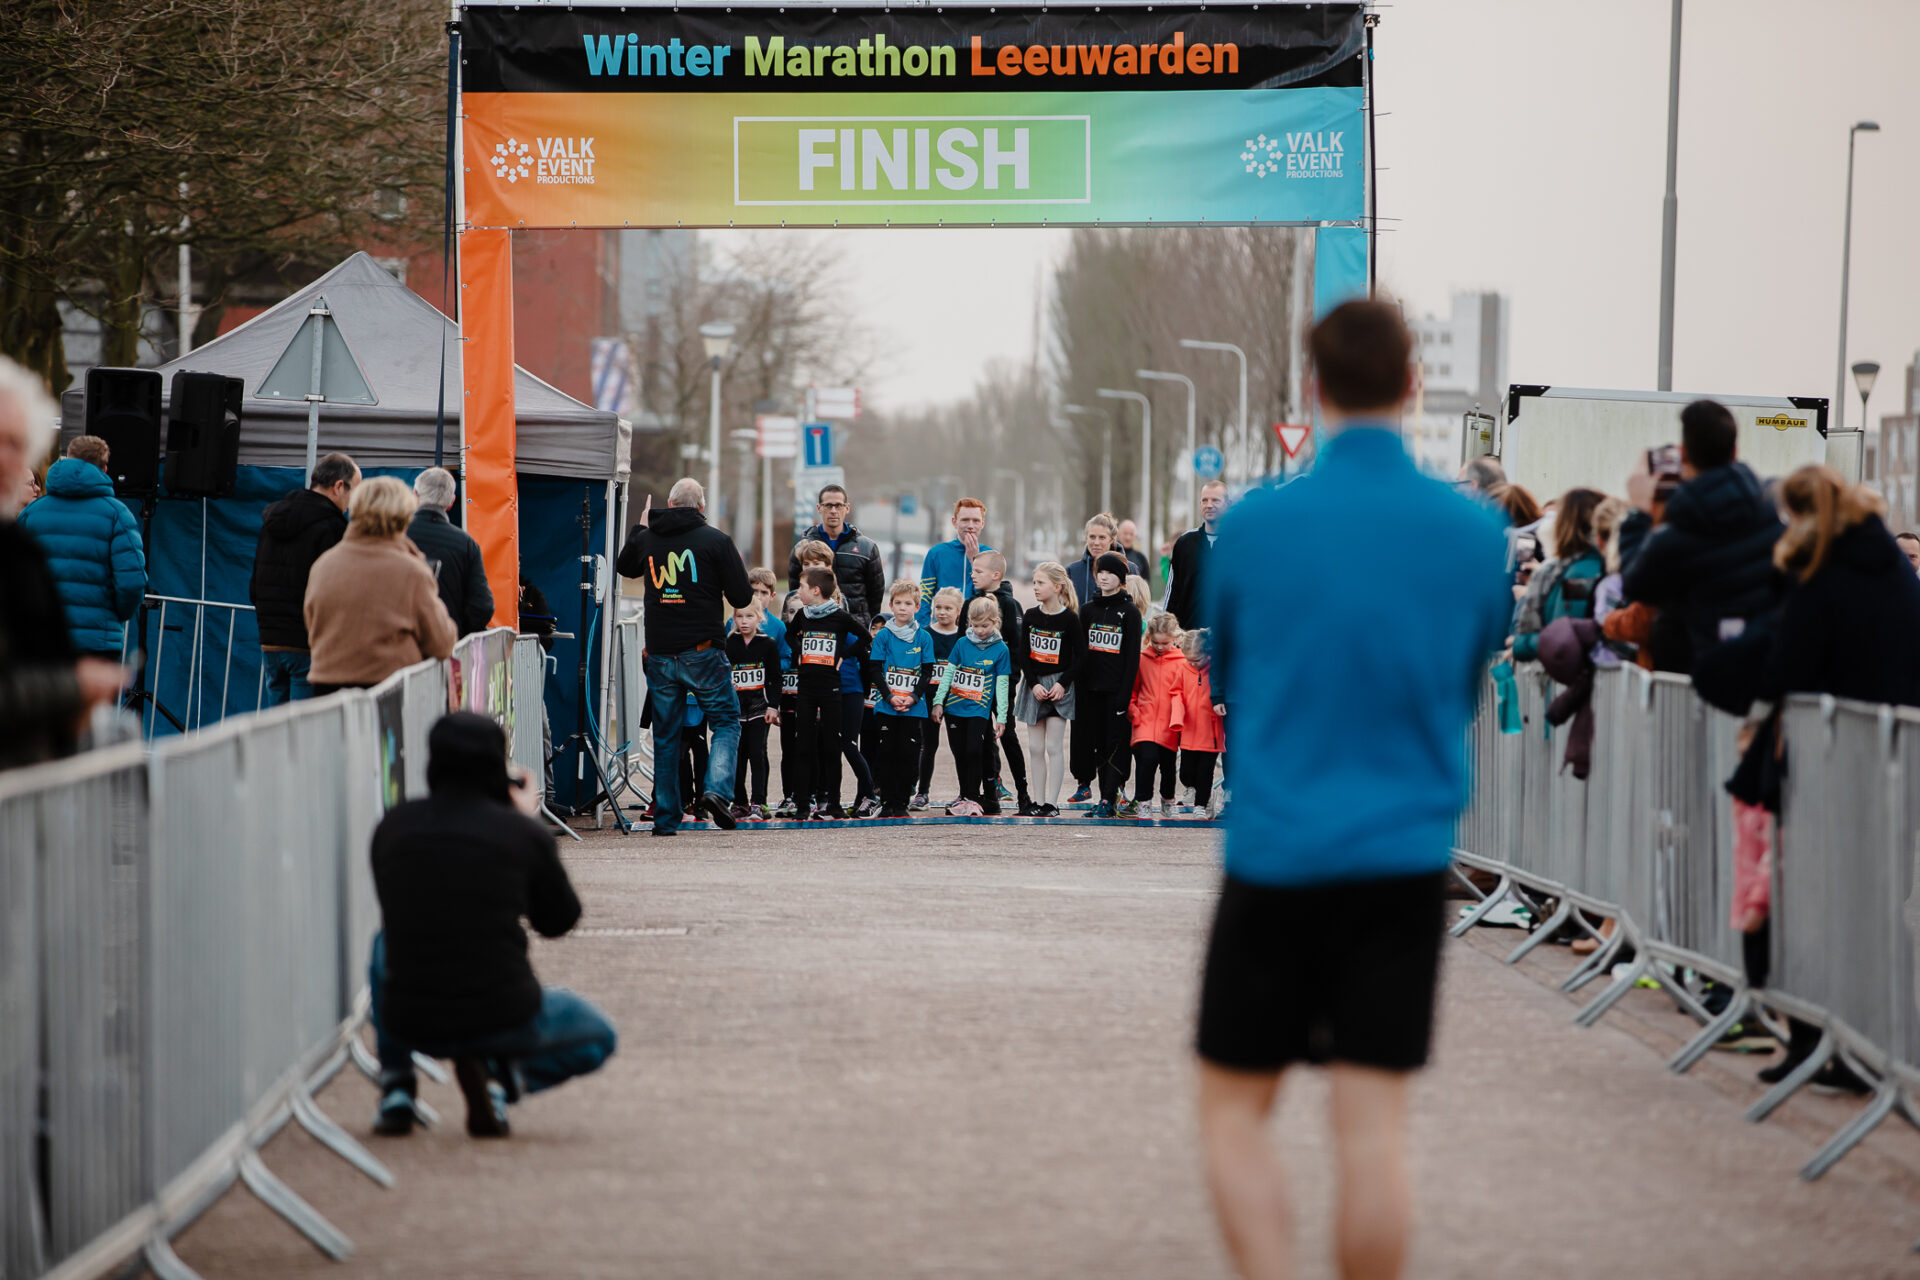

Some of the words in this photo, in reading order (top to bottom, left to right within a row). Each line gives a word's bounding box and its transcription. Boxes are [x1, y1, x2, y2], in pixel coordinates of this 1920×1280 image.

[583, 33, 731, 76] Winter
[744, 34, 956, 77] Marathon
[971, 31, 1239, 76] Leeuwarden
[536, 137, 595, 158] VALK
[1286, 131, 1344, 153] VALK
[798, 127, 1030, 191] FINISH
[1287, 153, 1344, 170] EVENT
[537, 159, 595, 176] EVENT
[1286, 170, 1344, 179] PRODUCTIONS
[537, 175, 595, 184] PRODUCTIONS
[1758, 418, 1806, 426] HUMBAUR
[803, 639, 833, 652] 5013
[1031, 635, 1058, 651] 5030
[1090, 630, 1119, 646] 5000
[733, 670, 763, 683] 5019
[888, 673, 918, 688] 5014
[953, 671, 982, 688] 5015
